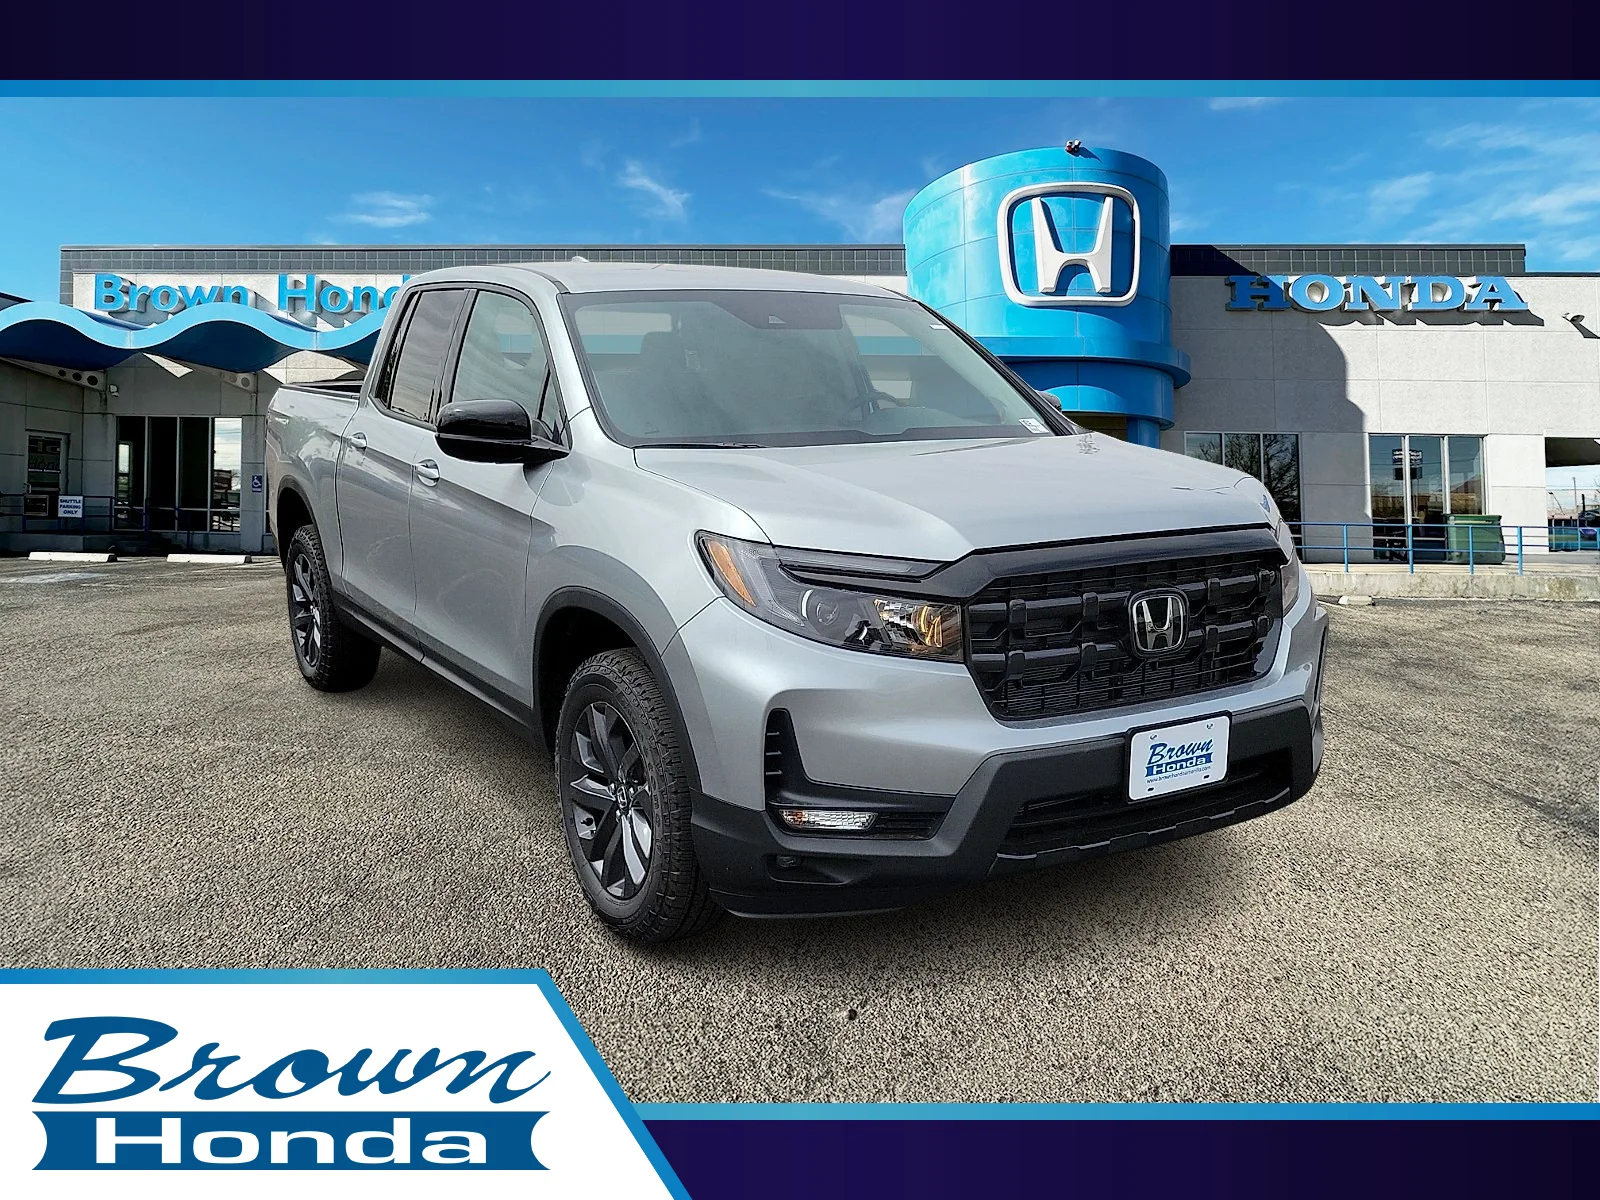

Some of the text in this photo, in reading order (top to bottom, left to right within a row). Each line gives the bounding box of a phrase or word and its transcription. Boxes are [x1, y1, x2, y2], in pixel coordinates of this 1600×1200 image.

[94, 273, 411, 312] Brown Hond
[1226, 274, 1529, 312] HONDA
[1146, 738, 1213, 766] Brown
[1153, 756, 1206, 775] Honda
